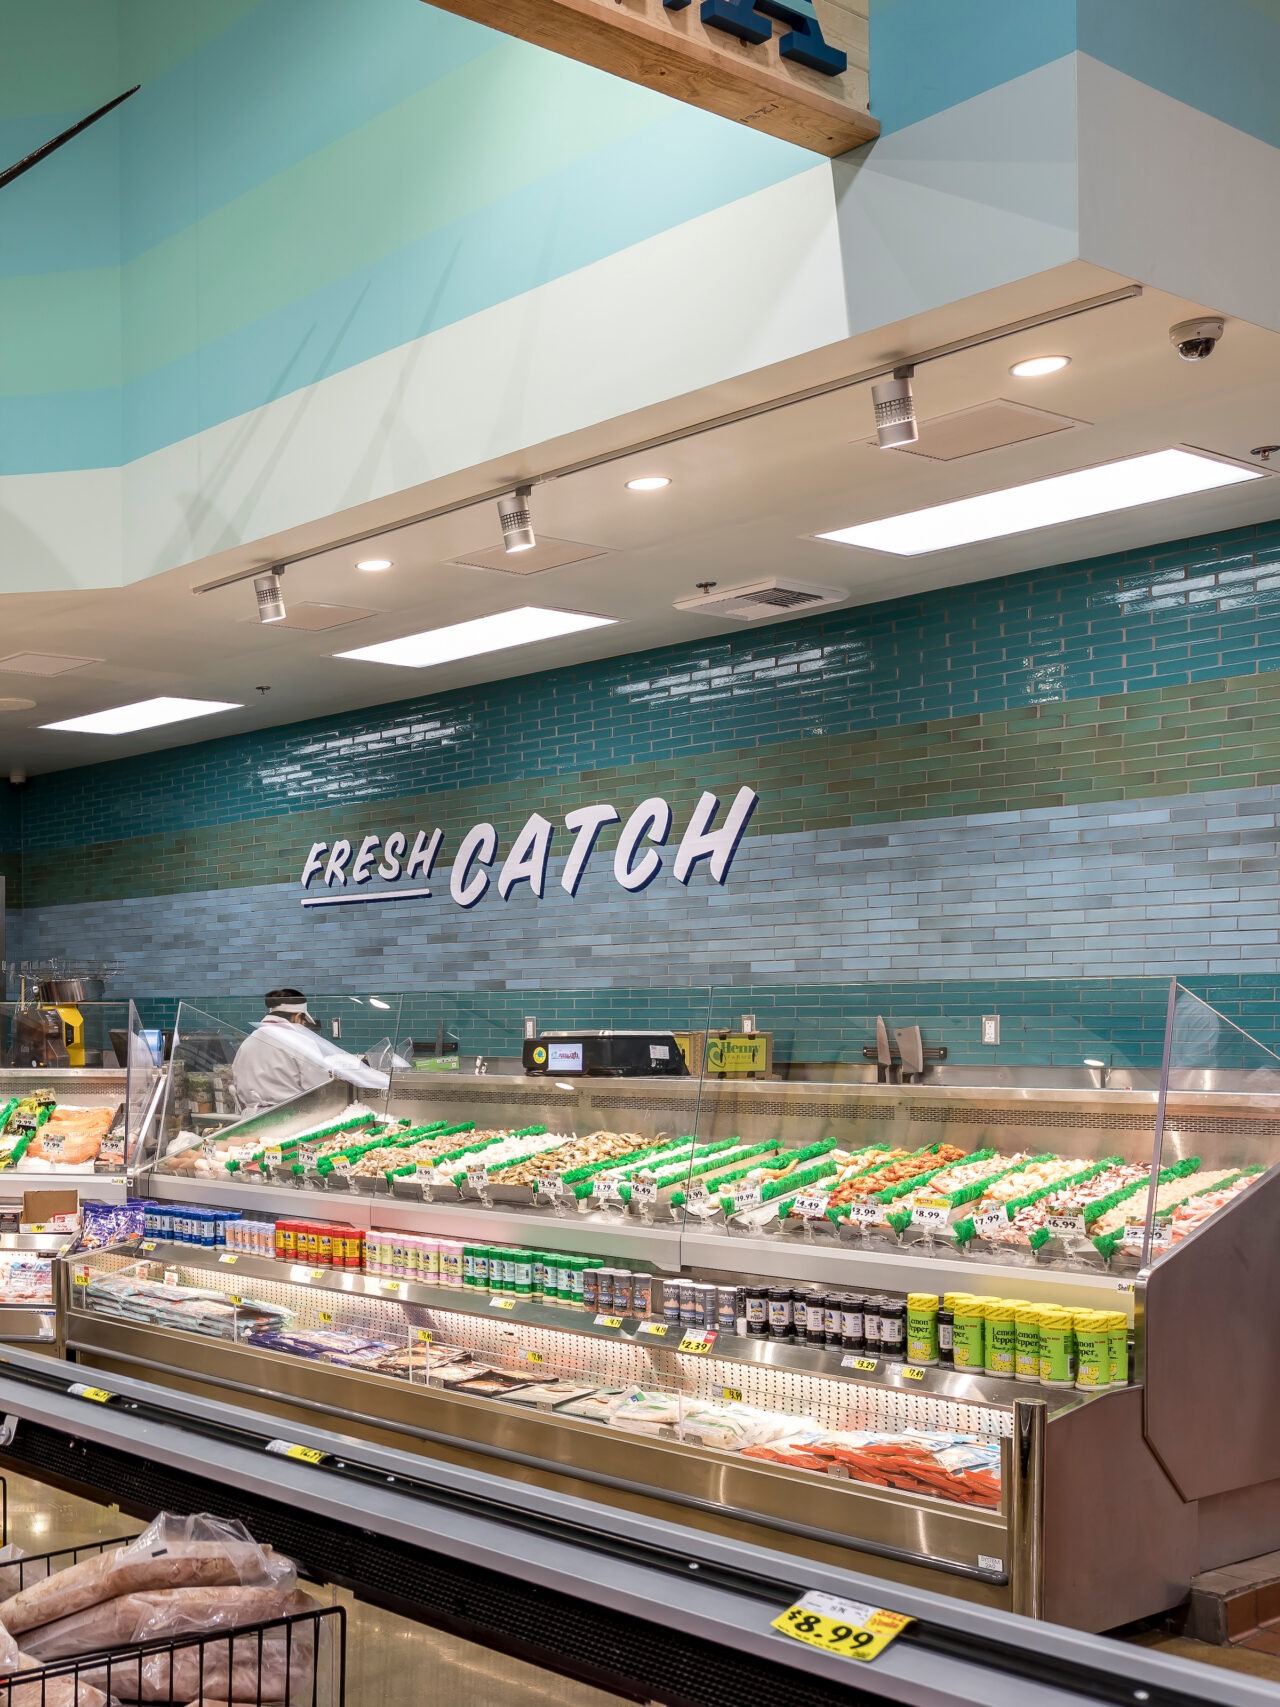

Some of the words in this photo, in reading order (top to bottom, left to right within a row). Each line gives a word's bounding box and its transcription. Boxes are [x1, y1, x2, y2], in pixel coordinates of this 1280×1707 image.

[450, 785, 759, 909] CATCH
[300, 828, 444, 889] FRESH
[721, 1042, 759, 1057] Henry
[538, 1180, 557, 1189] $3.99
[632, 1184, 652, 1195] $6.49
[796, 1199, 820, 1209] $4.49
[852, 1206, 876, 1217] $3.99
[915, 1209, 940, 1221] $8.99
[974, 1214, 1000, 1226] $7.99
[1048, 1218, 1077, 1229] $6.99
[682, 1339, 708, 1351] $2.39
[857, 1360, 876, 1370] $3.29
[909, 1368, 924, 1378] $7.49
[788, 1610, 874, 1650] $8.99
